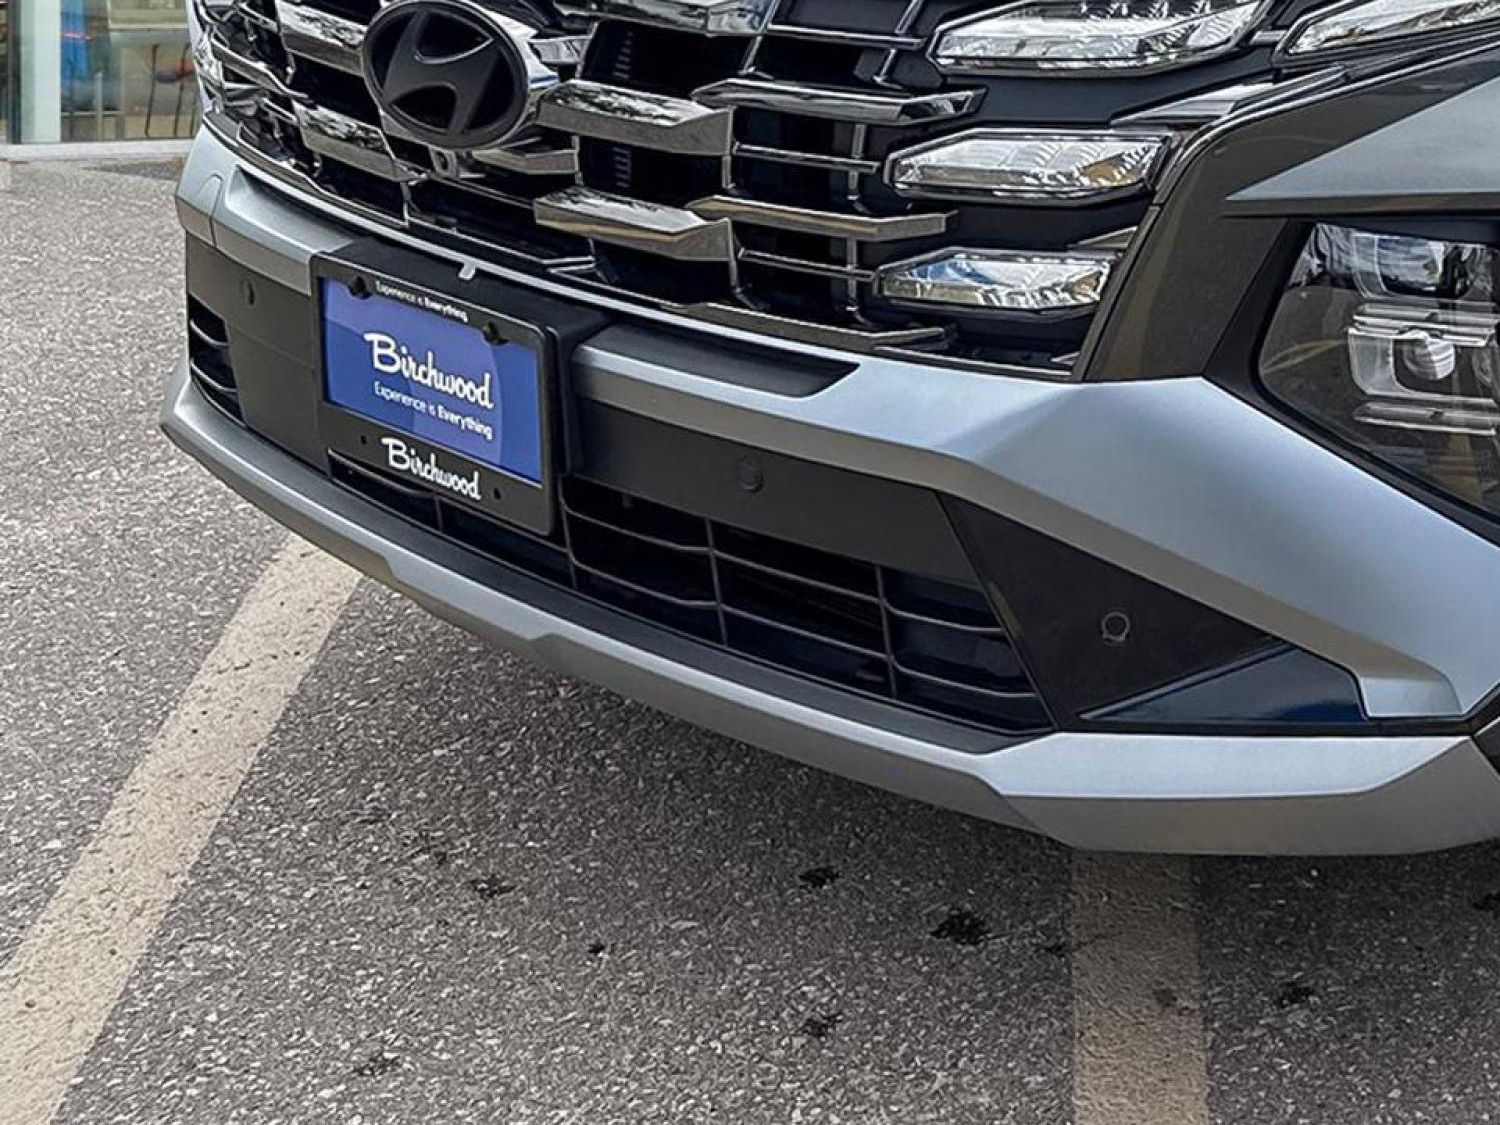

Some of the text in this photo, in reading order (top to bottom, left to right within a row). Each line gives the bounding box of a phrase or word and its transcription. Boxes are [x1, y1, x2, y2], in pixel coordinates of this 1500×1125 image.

[375, 279, 416, 304] Experience
[425, 296, 468, 323] Everything
[364, 332, 494, 409] Birchwood
[374, 380, 426, 413] Experience
[437, 404, 493, 441] Everything
[381, 437, 482, 501] Birchwood
